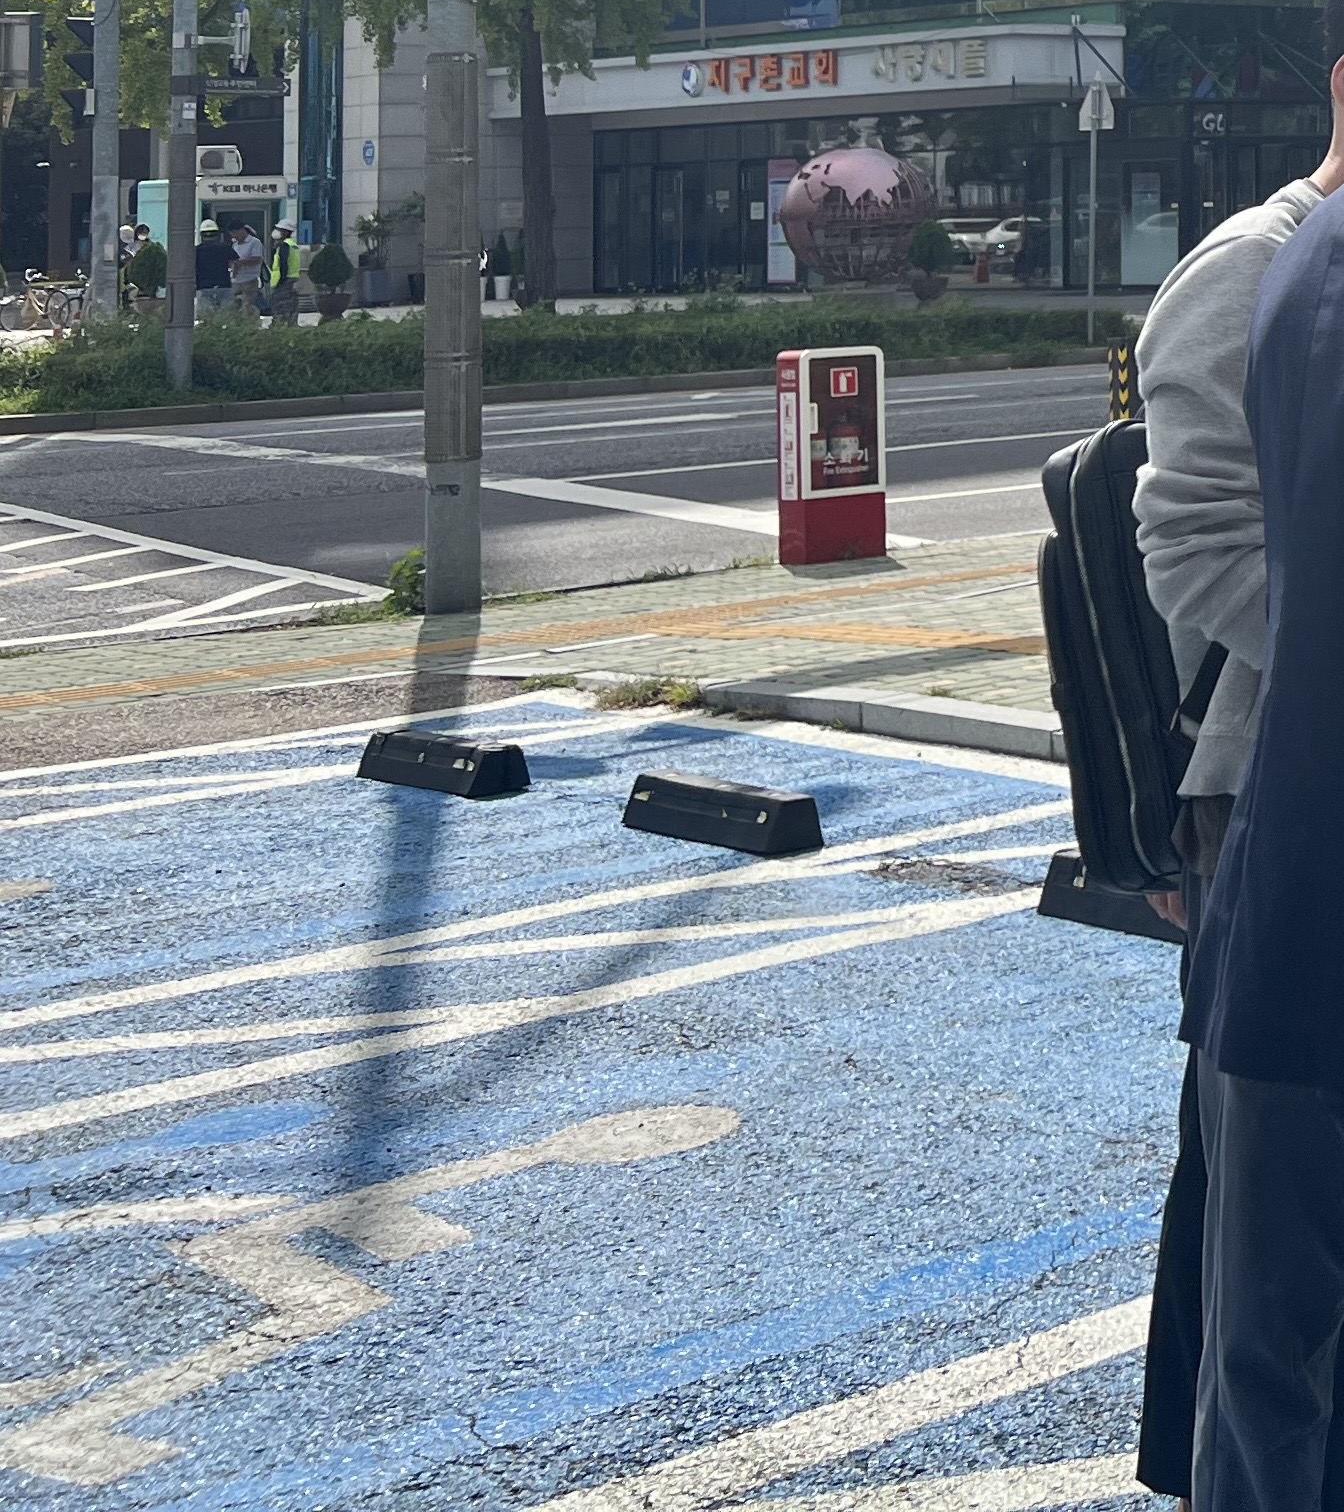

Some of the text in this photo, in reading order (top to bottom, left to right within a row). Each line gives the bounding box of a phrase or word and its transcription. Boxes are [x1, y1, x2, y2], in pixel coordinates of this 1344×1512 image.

[708, 48, 838, 94] 지구촌교회
[223, 184, 277, 194] KEB 하나은행
[823, 447, 869, 465] 소화기
